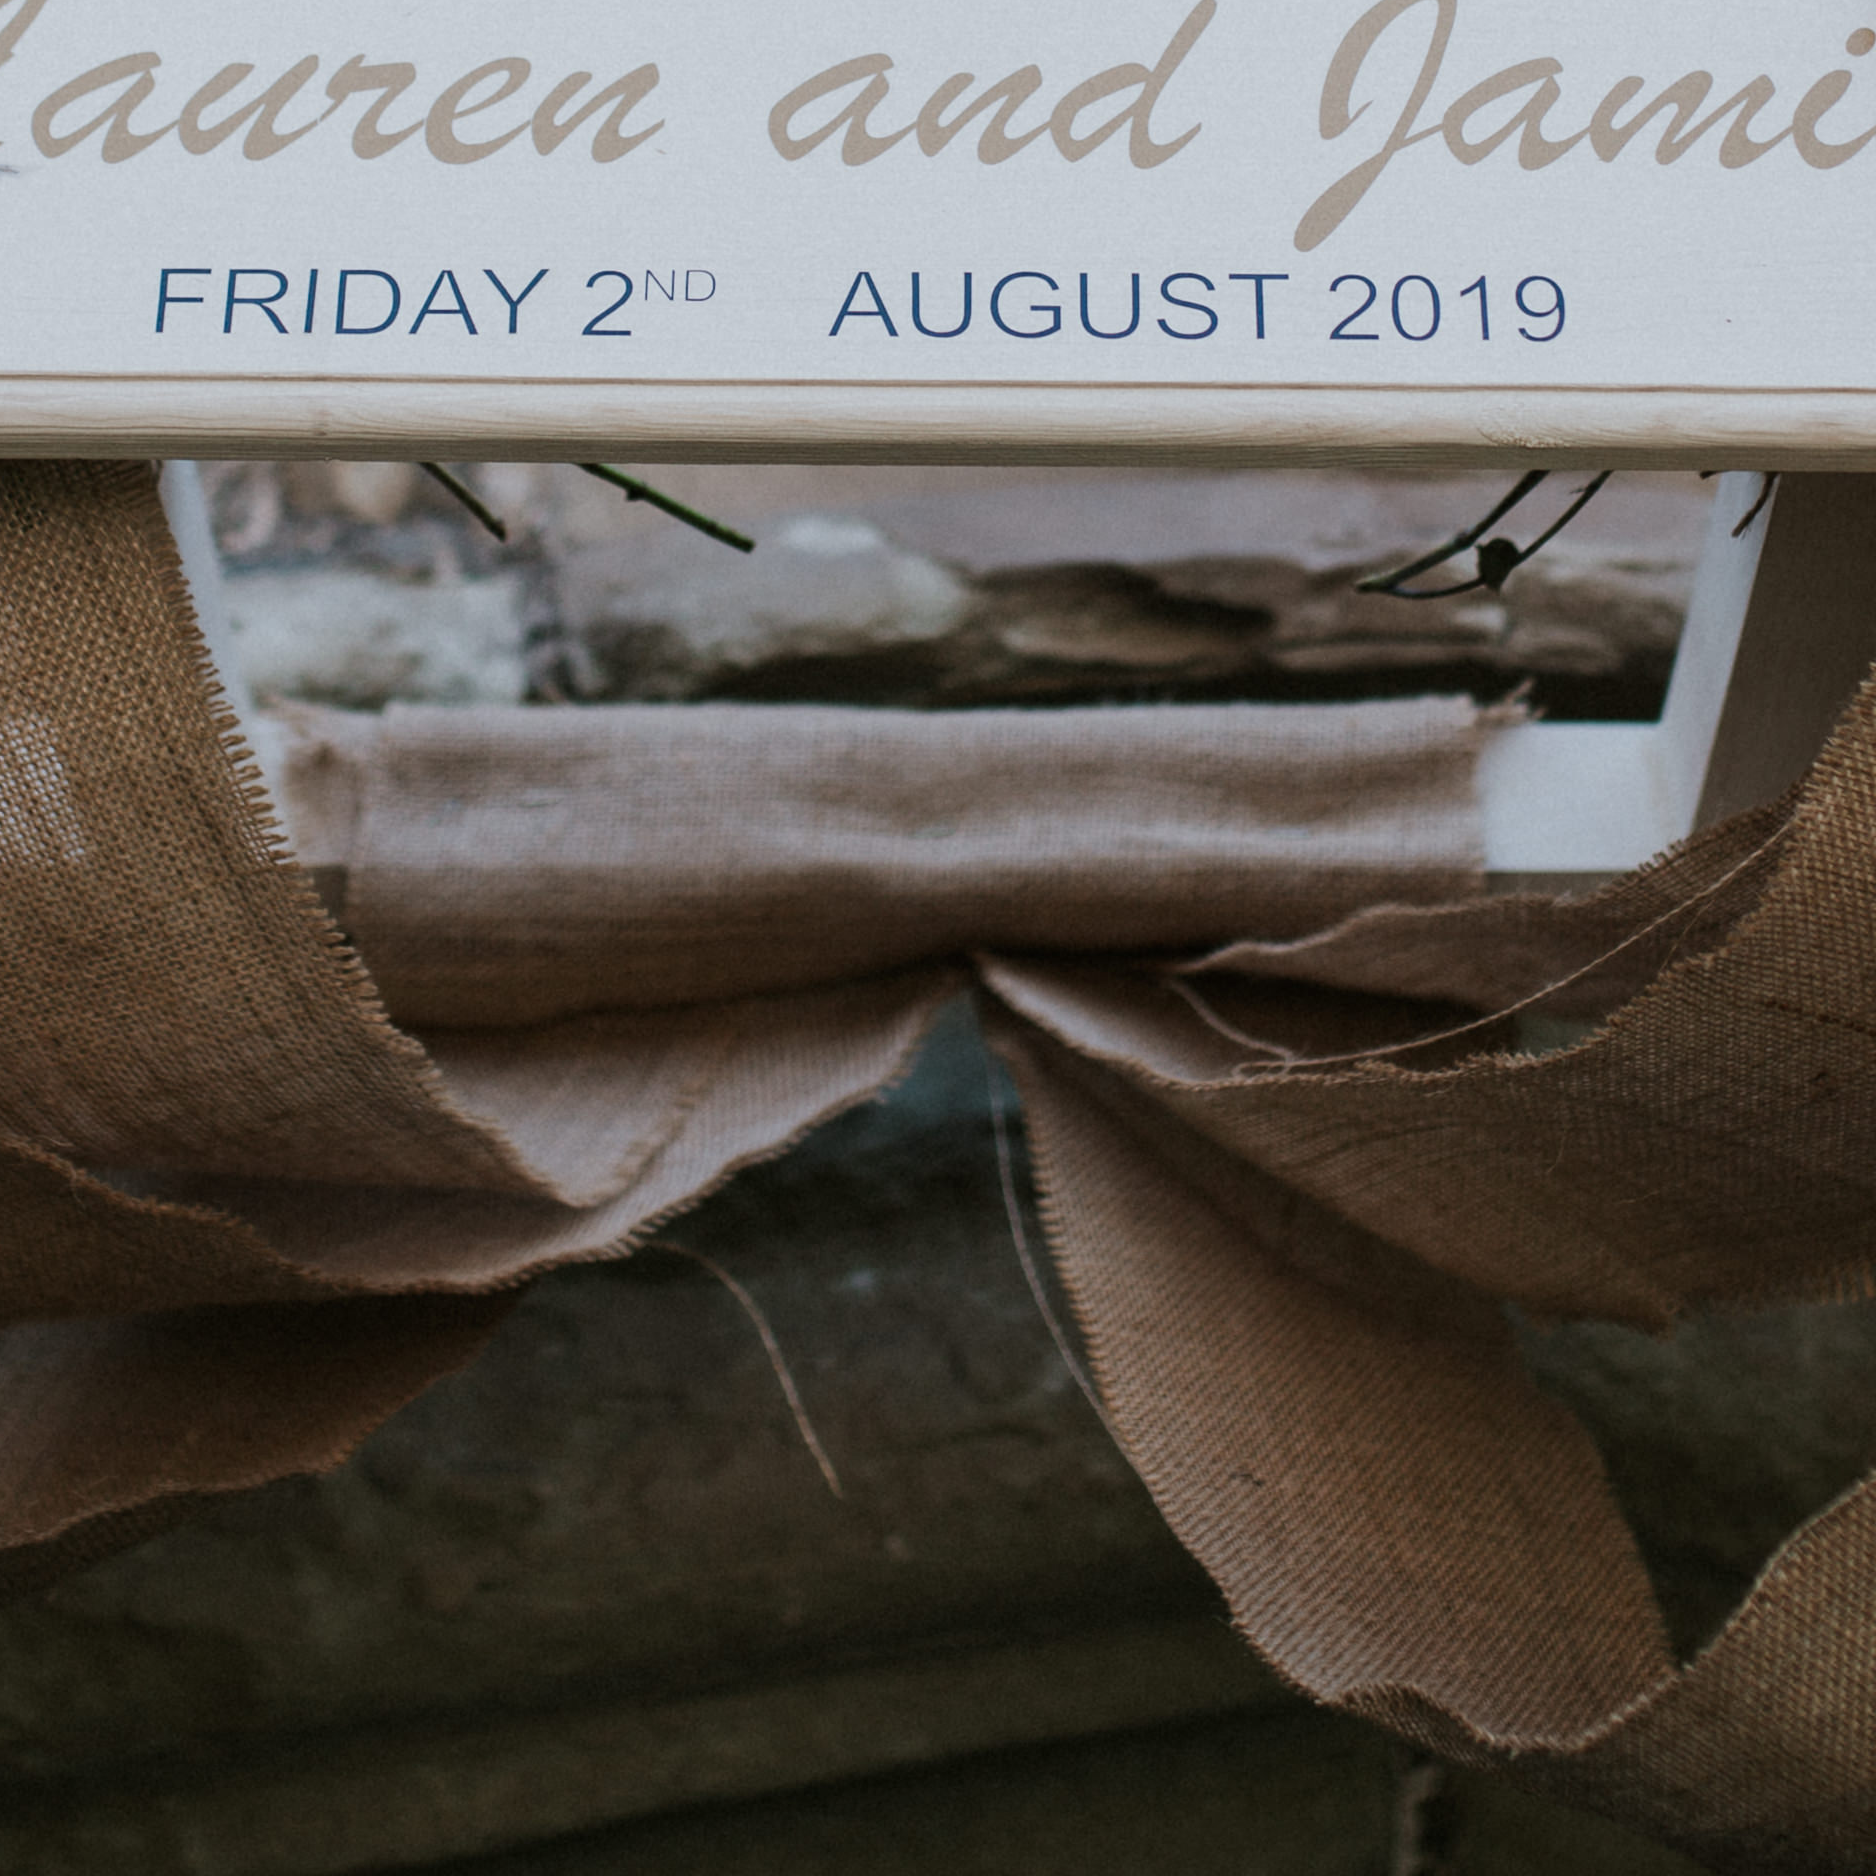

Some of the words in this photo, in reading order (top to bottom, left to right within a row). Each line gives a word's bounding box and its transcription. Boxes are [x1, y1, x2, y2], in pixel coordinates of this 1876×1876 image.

[154, 267, 551, 336] FRIDAY
[581, 267, 719, 338] 2ND
[827, 270, 1290, 341] AUGUST
[1328, 273, 1566, 343] 2019
